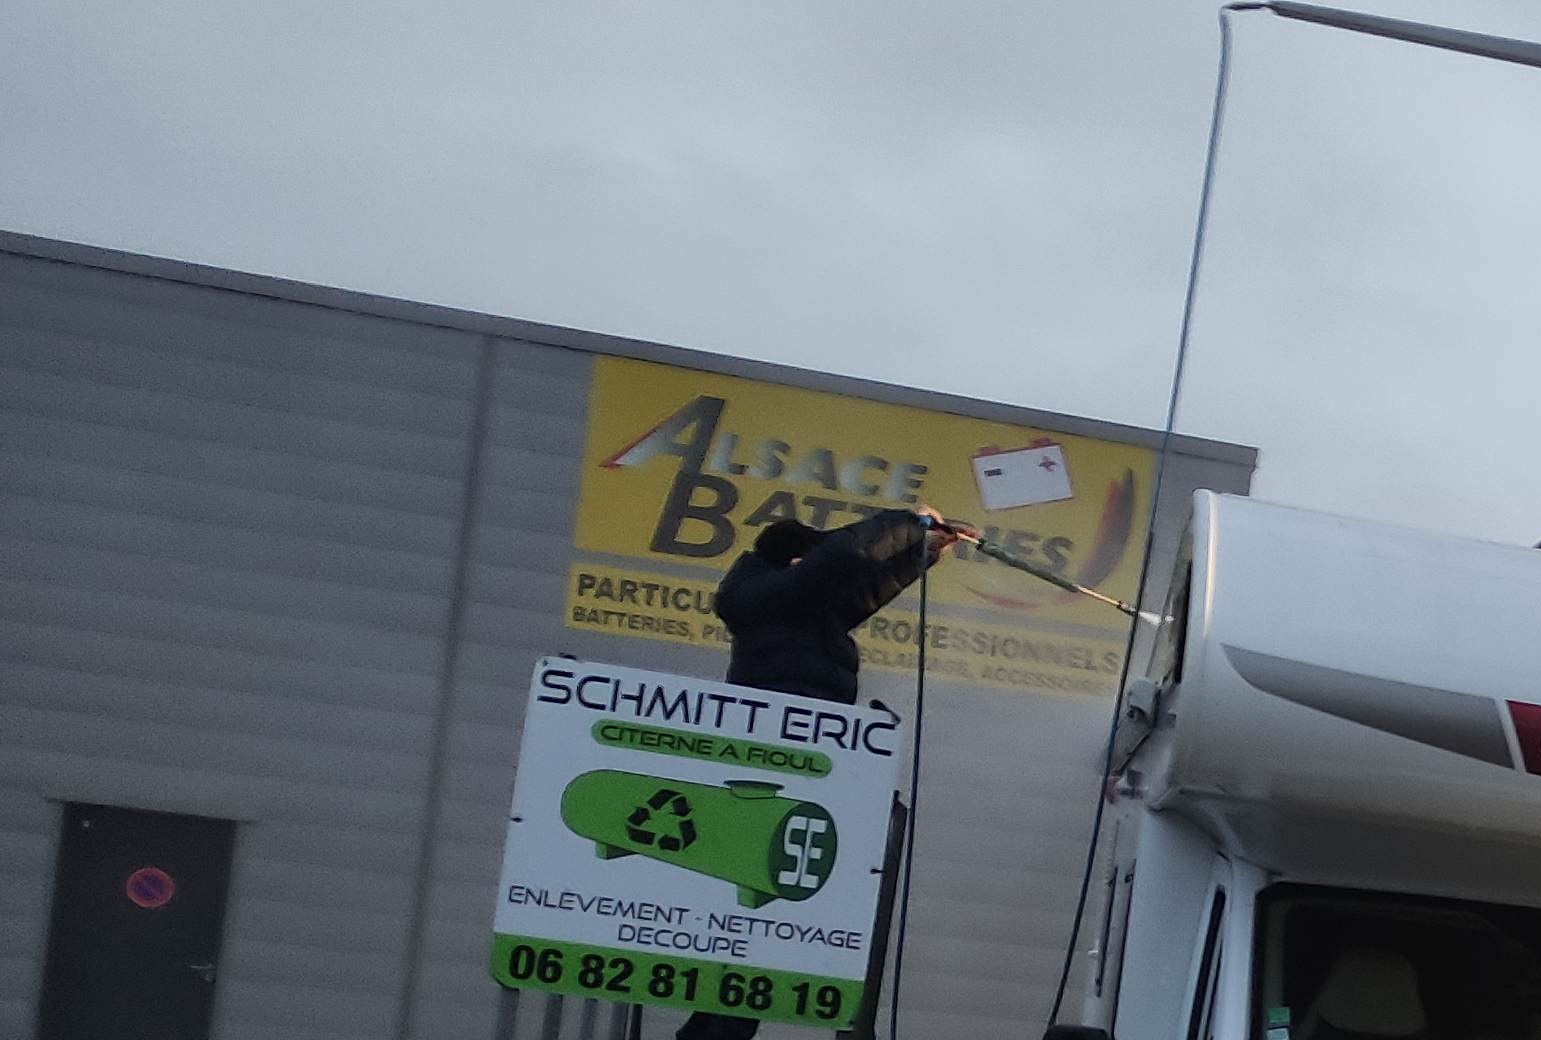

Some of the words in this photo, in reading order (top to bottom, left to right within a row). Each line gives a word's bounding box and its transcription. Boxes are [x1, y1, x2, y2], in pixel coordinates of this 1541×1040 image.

[598, 395, 928, 503] ALSACE
[578, 573, 716, 614] PARTICU
[537, 669, 769, 734] SCHMITT
[780, 705, 896, 757] ERIC
[600, 724, 712, 756] CITERNE
[718, 742, 739, 760] A
[747, 747, 823, 774] FIOUL
[777, 815, 828, 889] SE
[508, 885, 691, 926] ENLEVEMENT
[707, 912, 862, 950] NETTOYAGE
[618, 923, 749, 958] DECOUPE
[508, 944, 564, 984] 06
[578, 953, 635, 993] 82
[648, 963, 699, 1001] 81
[719, 972, 773, 1011] 68
[791, 981, 842, 1019] 19
